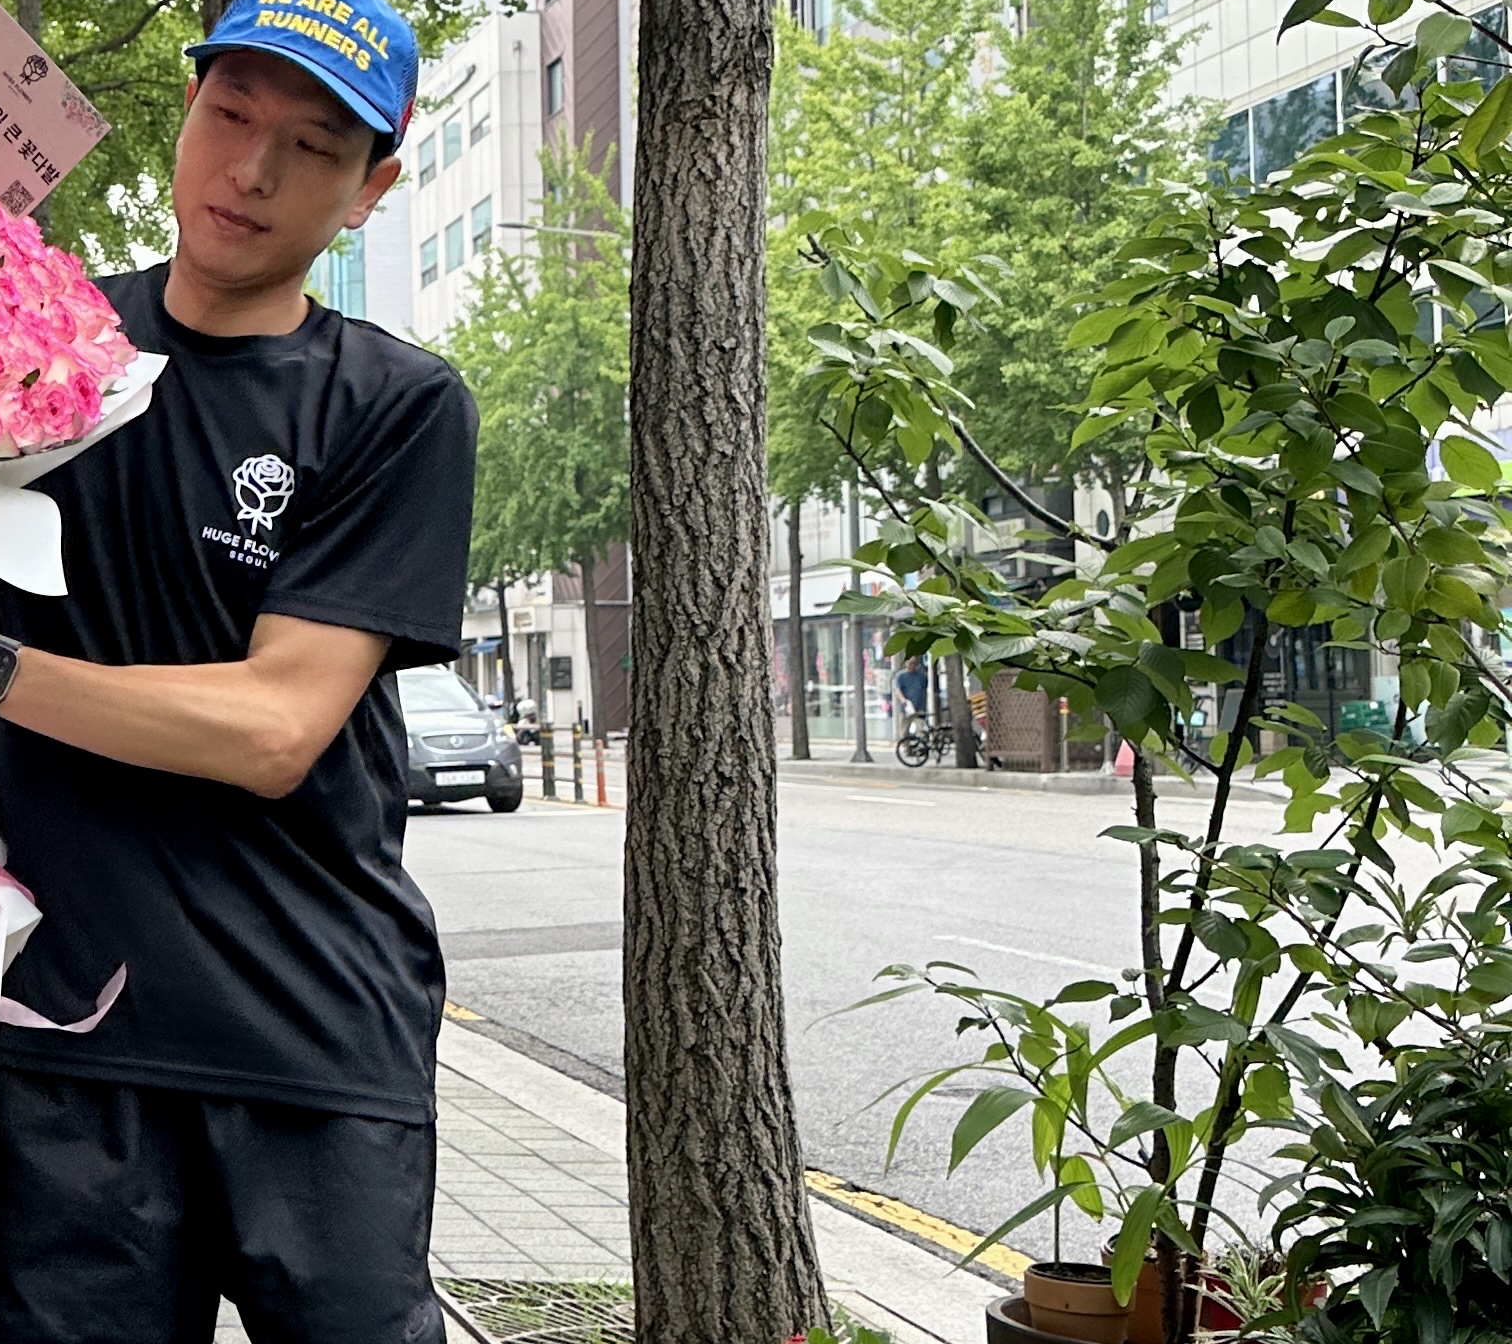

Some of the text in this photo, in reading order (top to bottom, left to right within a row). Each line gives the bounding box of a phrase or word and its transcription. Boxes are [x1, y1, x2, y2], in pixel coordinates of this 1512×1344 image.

[255, 9, 371, 73] RUNNERS
[352, 15, 390, 61] ALL
[3, 123, 23, 144] 큰
[18, 139, 61, 186] 꽃다발
[201, 526, 280, 562] HUGE FLOW
[229, 550, 268, 569] SEOUL
